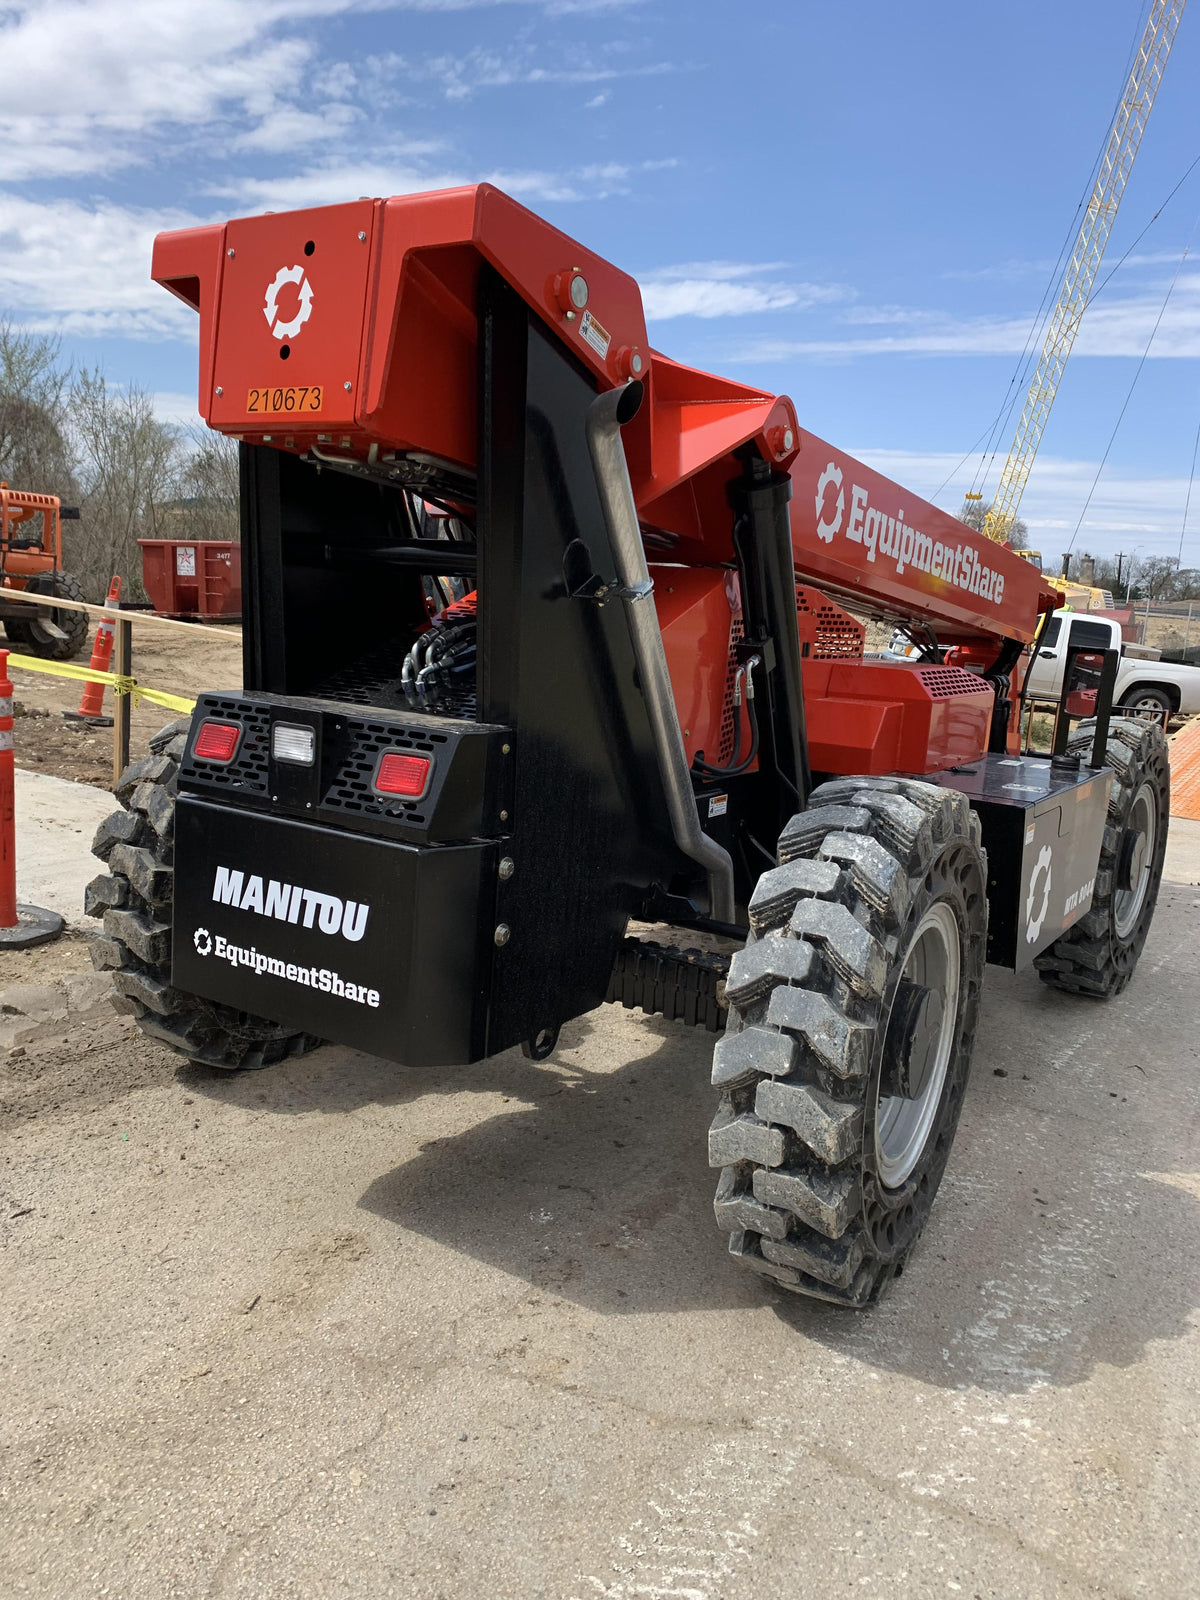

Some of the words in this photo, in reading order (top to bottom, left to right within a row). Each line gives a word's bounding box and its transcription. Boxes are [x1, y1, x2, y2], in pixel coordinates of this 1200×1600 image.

[248, 387, 321, 412] 210673
[845, 484, 1005, 605] EquipmentShare
[212, 866, 370, 942] MANITOU
[214, 935, 381, 1008] EquipmentShare
